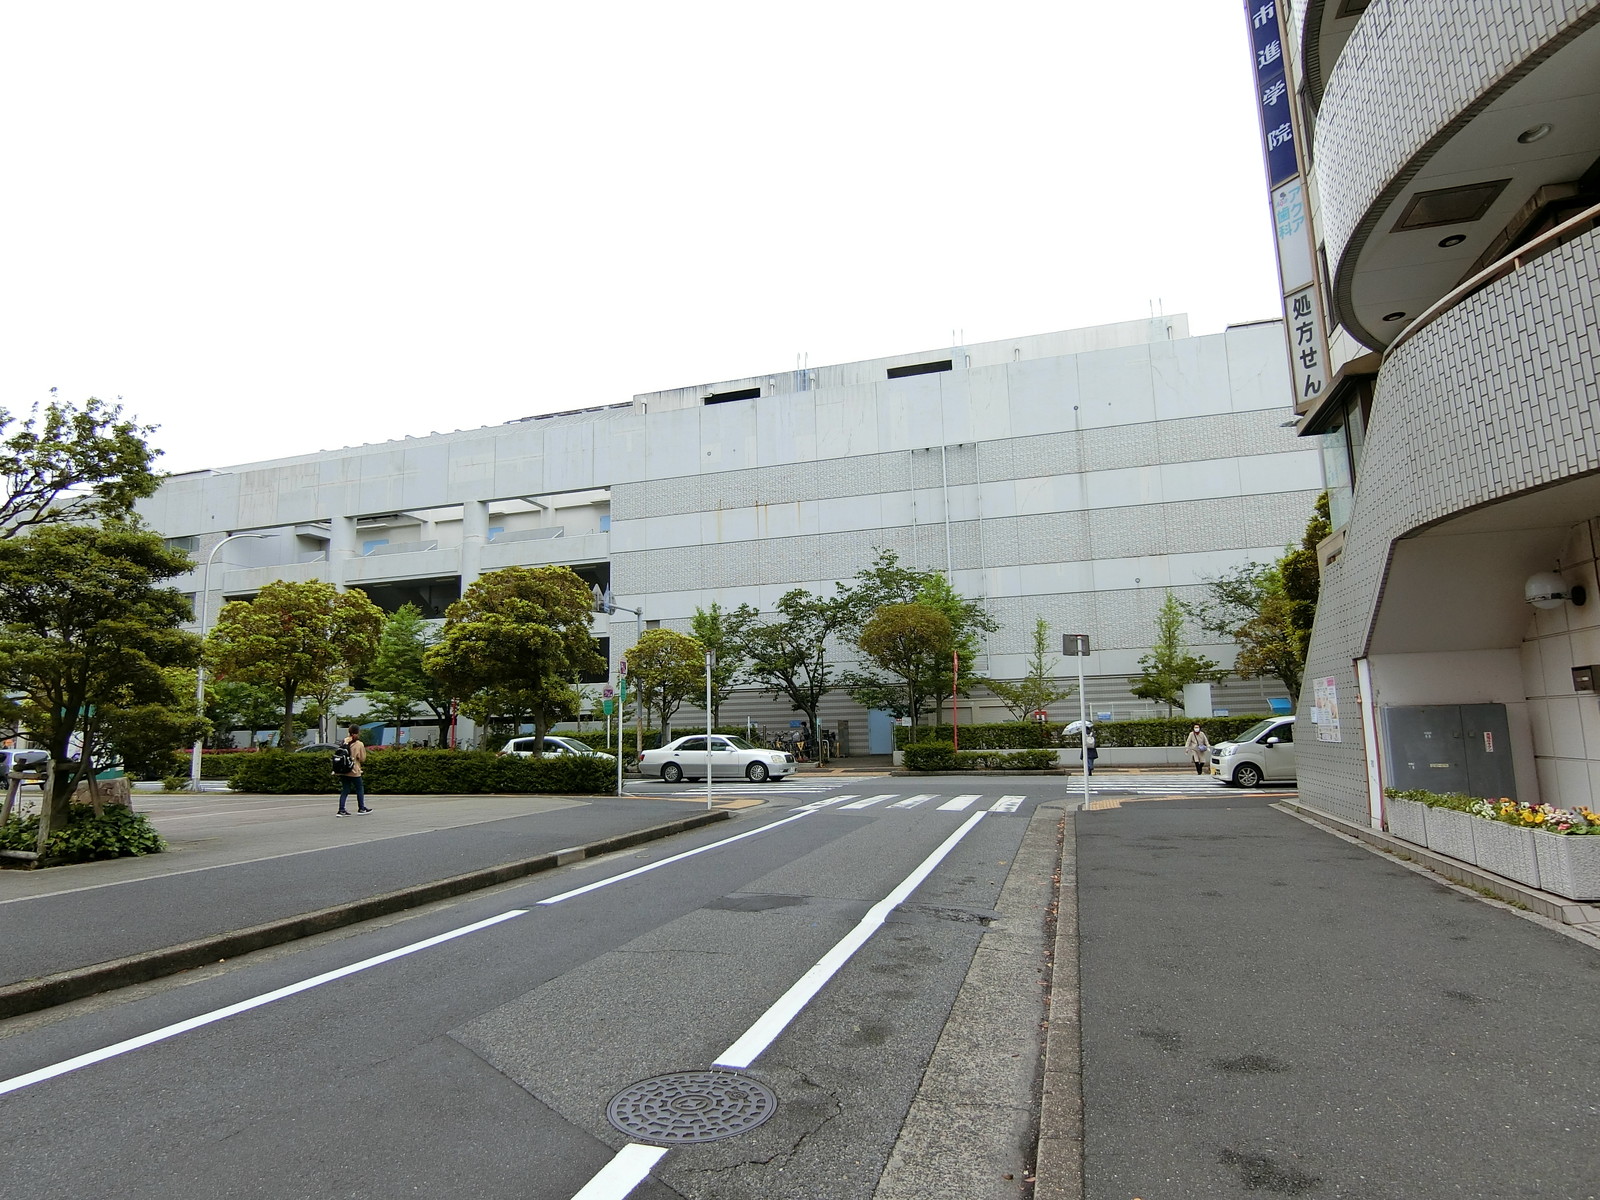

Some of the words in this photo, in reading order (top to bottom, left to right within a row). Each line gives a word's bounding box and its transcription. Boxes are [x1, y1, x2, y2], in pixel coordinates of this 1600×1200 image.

[1252, 1, 1292, 151] 市進学院
[1277, 206, 1292, 239] 歯科
[1288, 186, 1304, 233] アクア
[1293, 294, 1321, 397] 処方せん
